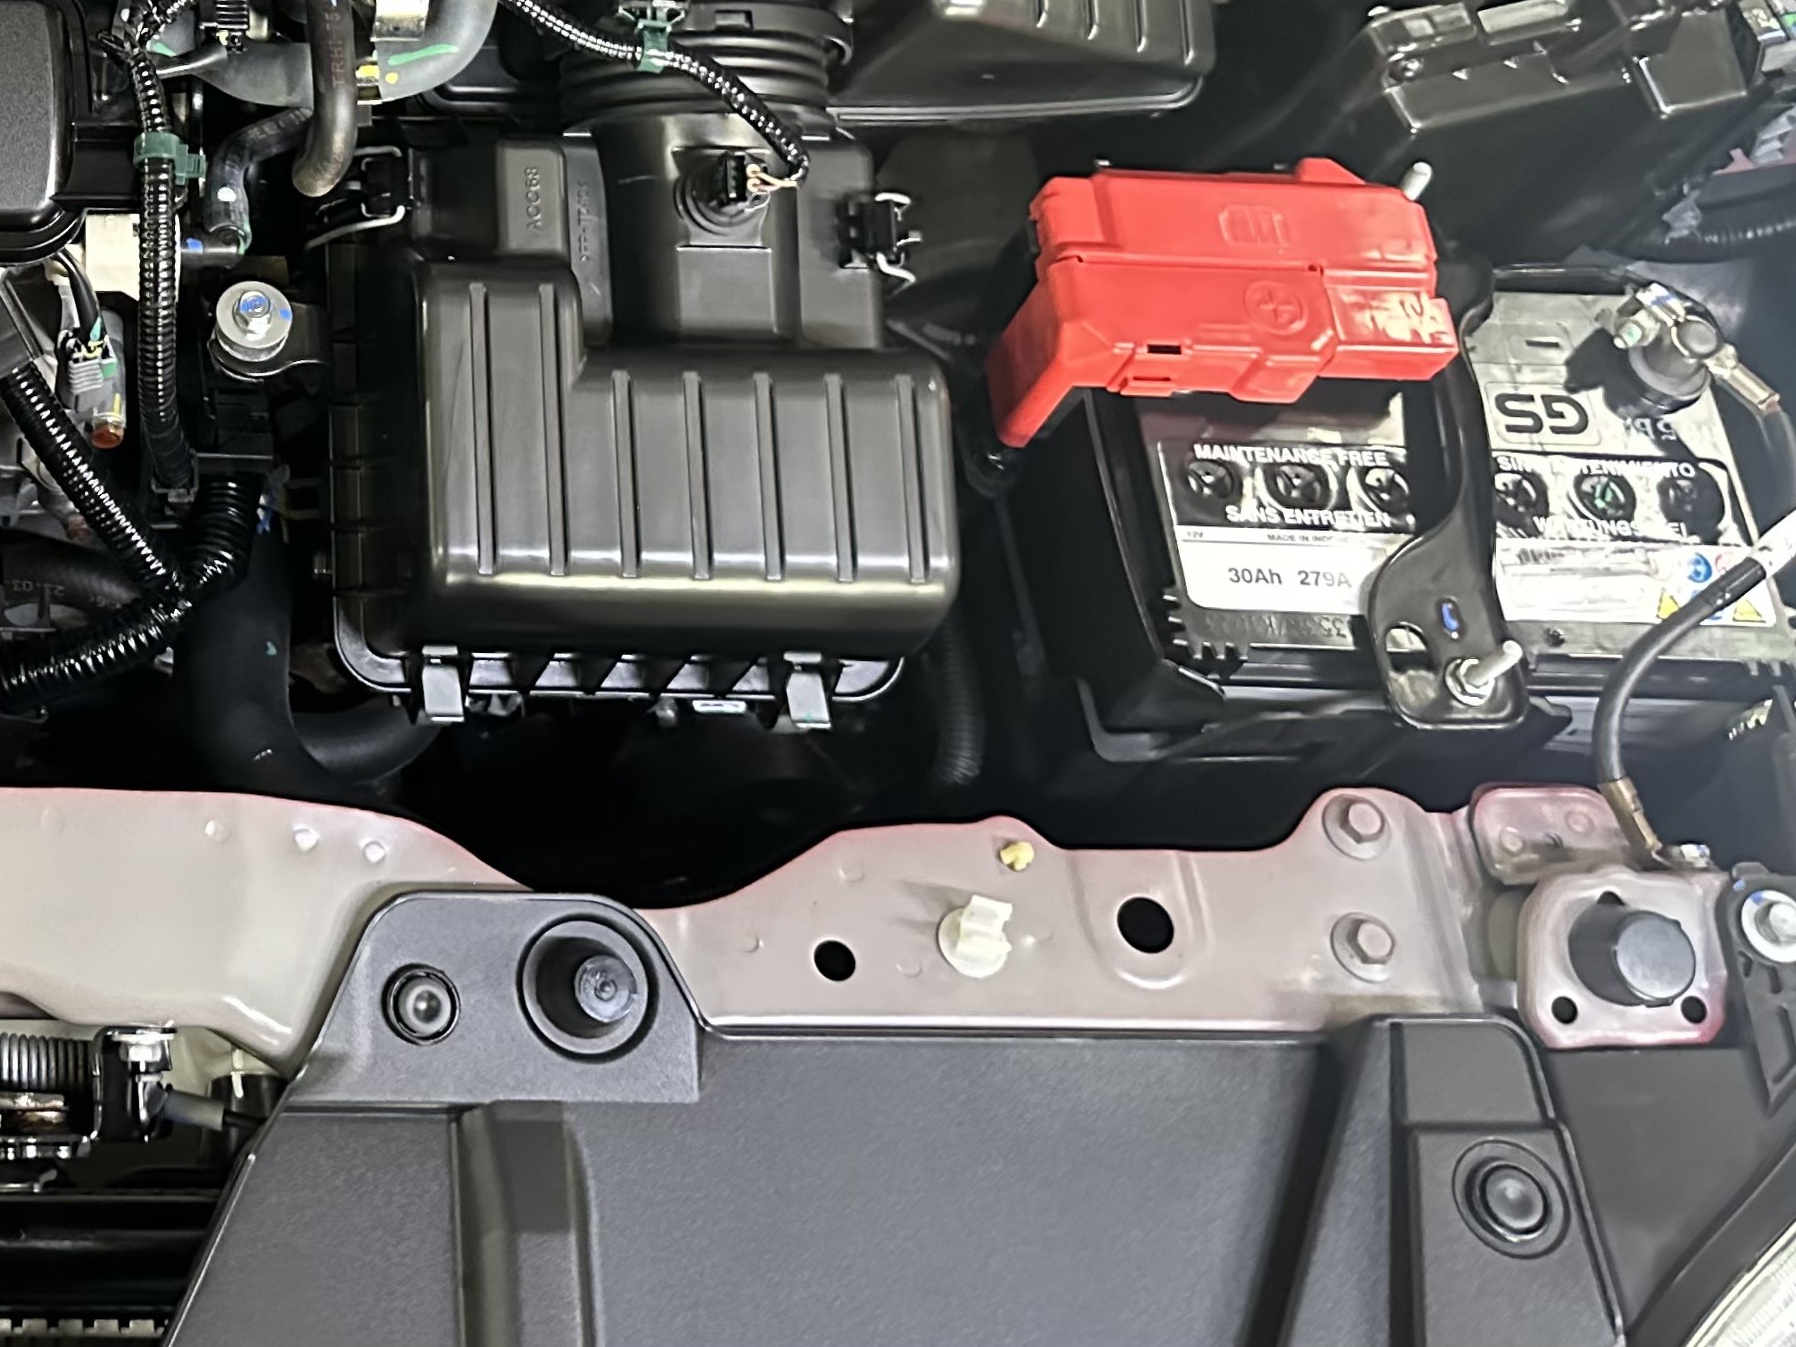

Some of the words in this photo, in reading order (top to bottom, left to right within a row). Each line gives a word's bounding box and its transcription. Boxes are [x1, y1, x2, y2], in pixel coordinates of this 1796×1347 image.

[1494, 392, 1589, 435] GS
[1336, 450, 1391, 467] FREE
[1225, 505, 1281, 524] SANS
[1227, 567, 1283, 586] 30Ah
[1297, 570, 1353, 589] 279A
